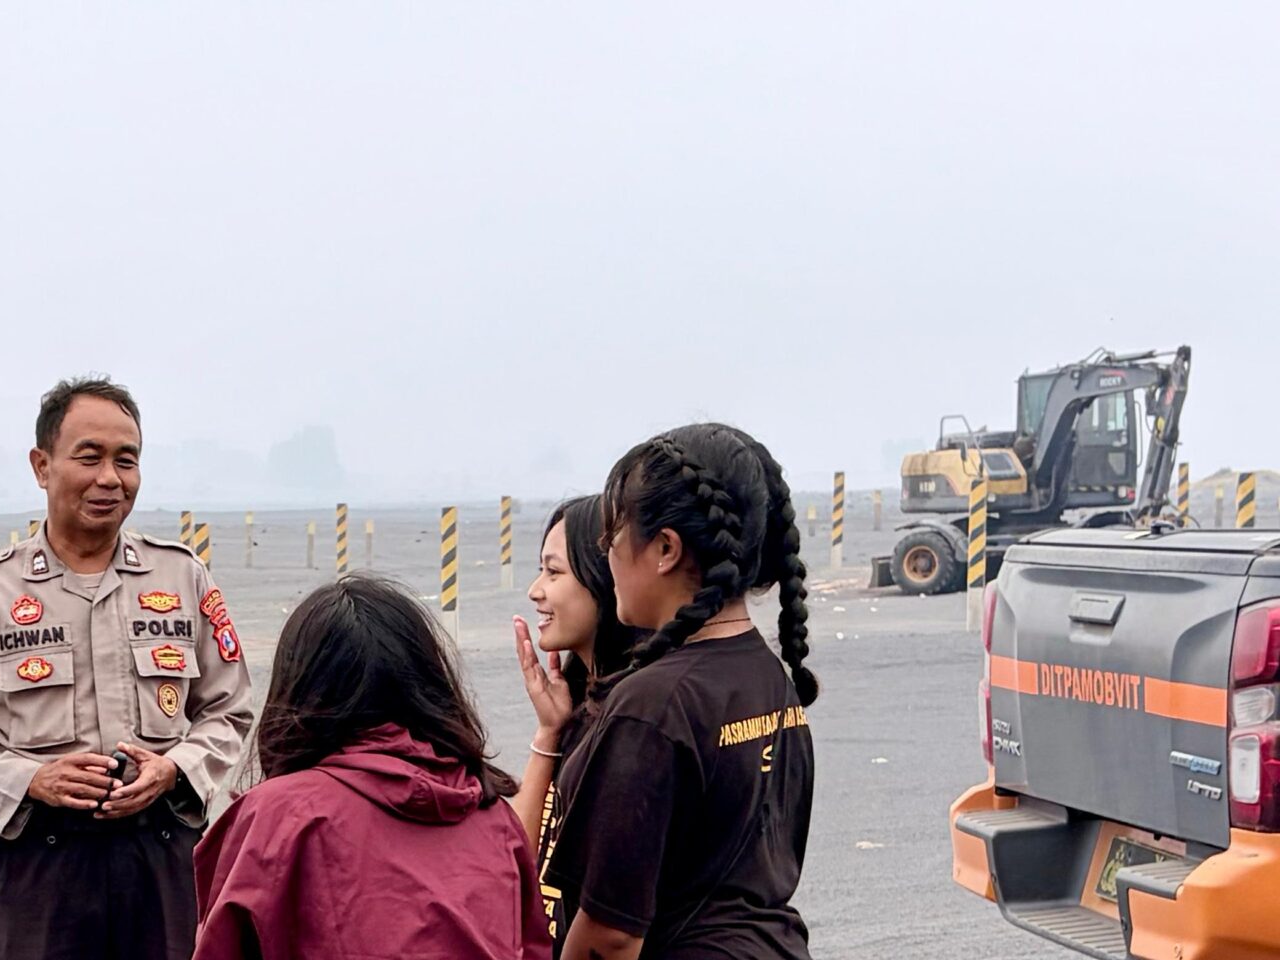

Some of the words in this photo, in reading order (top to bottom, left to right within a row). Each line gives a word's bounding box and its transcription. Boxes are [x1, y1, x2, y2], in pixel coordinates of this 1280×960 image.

[0, 626, 65, 651] ICHWAN
[133, 619, 193, 638] POLRI
[1040, 663, 1141, 710] DITPAMOBVIT
